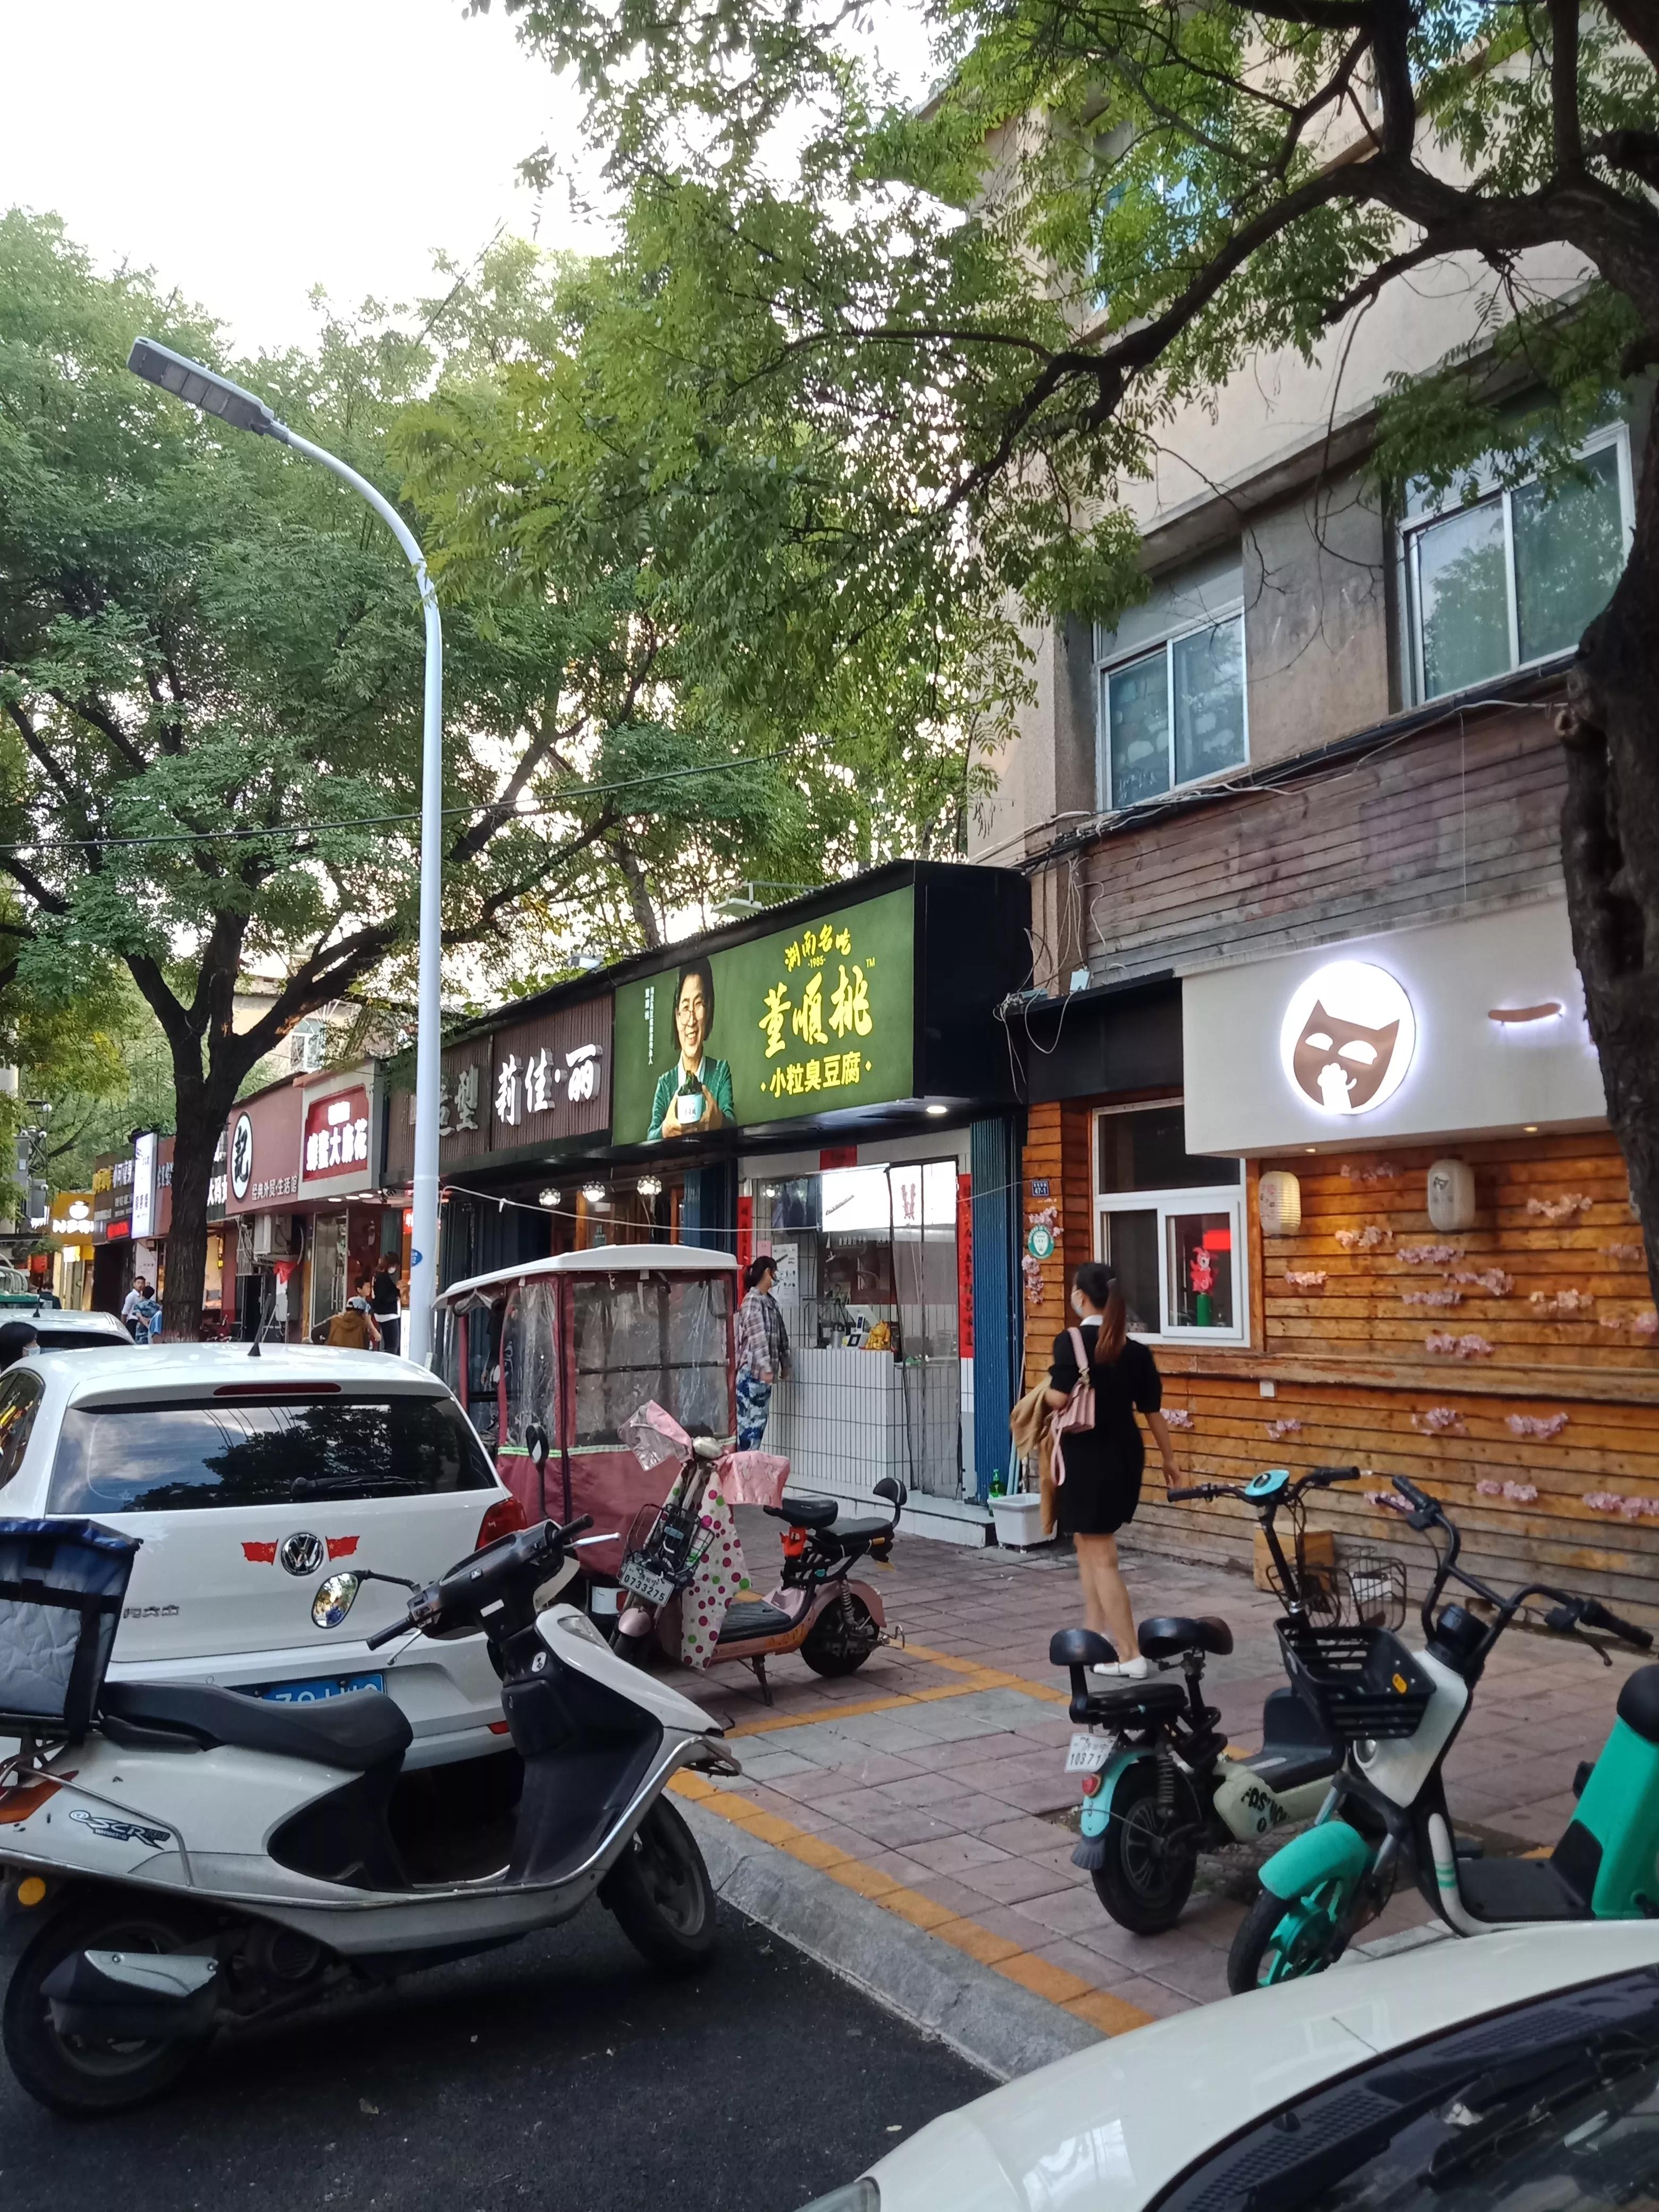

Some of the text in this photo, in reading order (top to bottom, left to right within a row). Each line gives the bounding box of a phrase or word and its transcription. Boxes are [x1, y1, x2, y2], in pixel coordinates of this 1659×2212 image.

[784, 924, 851, 972] 湖南名吃
[769, 1051, 861, 1098] 小粒臭豆腐
[624, 1574, 665, 1602] 0733275
